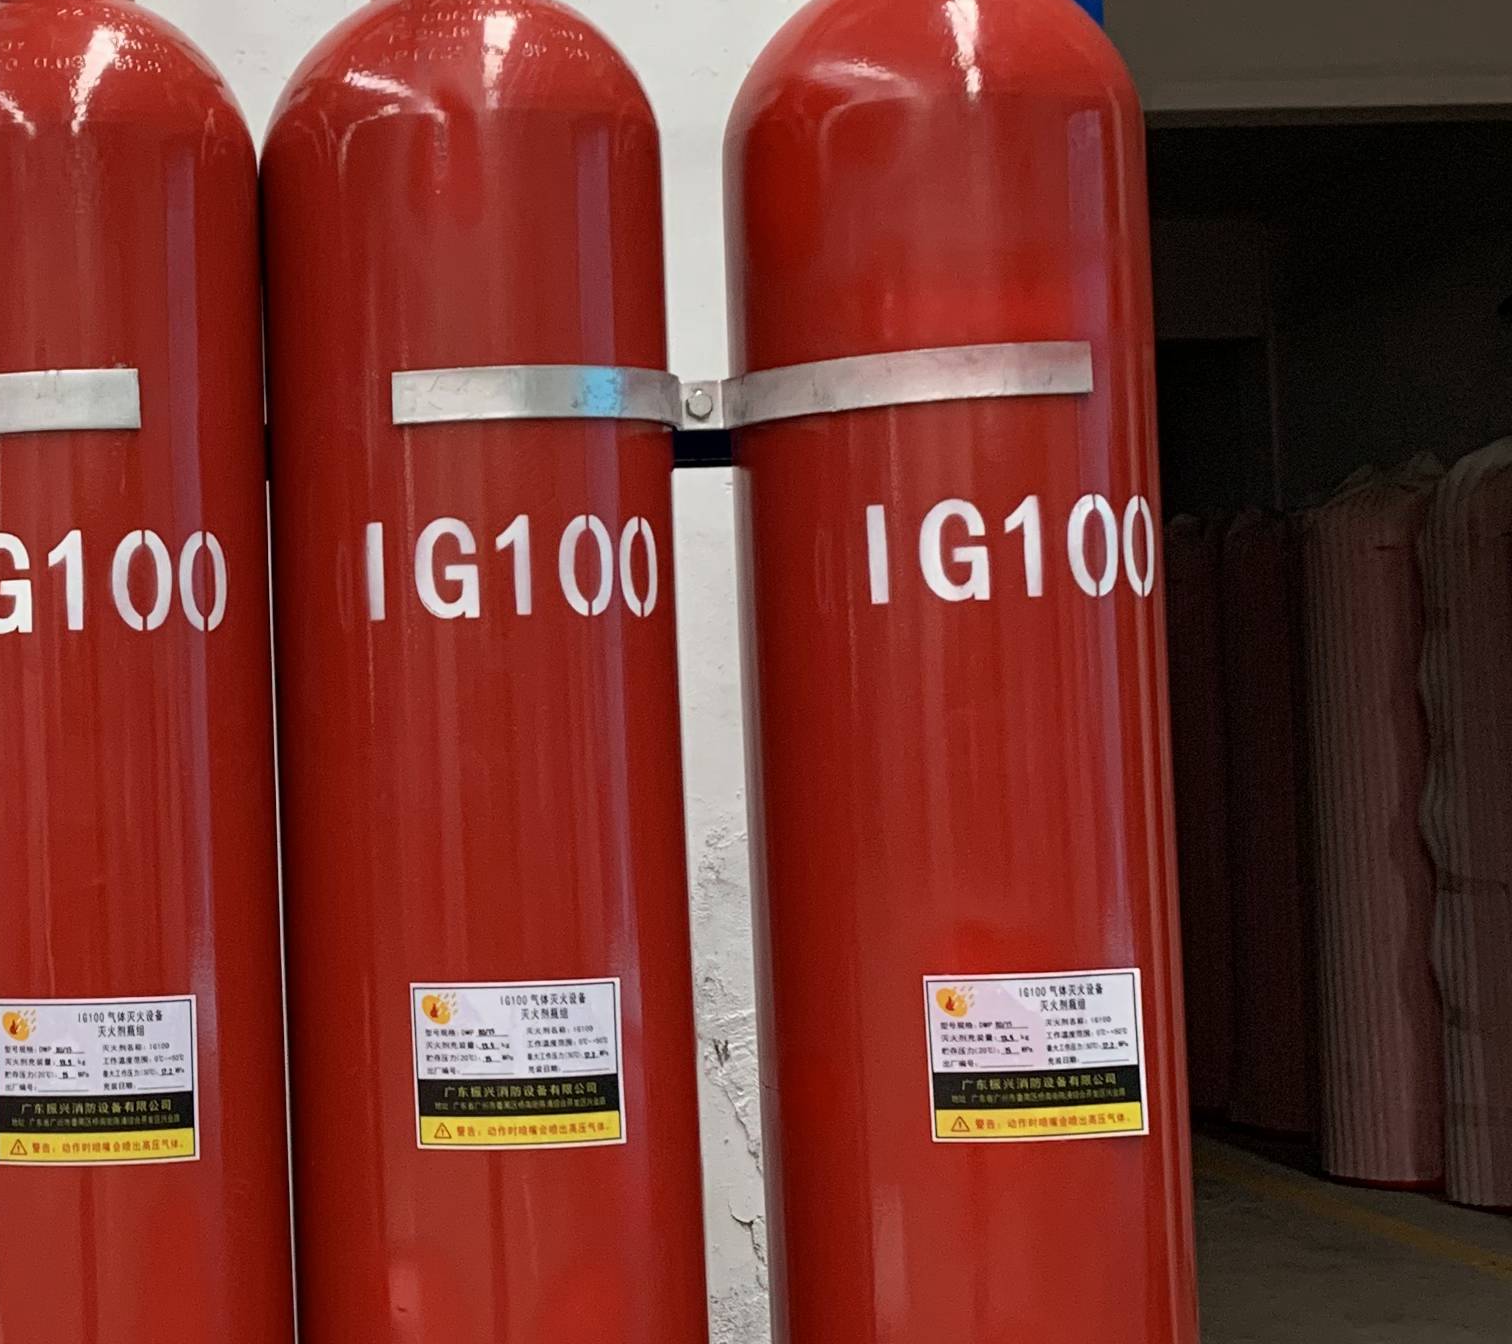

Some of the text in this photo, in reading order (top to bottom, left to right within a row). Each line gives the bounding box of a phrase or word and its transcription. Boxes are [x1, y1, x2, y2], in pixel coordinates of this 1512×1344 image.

[866, 493, 1154, 605] IG100
[365, 513, 659, 621] IG100
[1019, 984, 1103, 997] IG100 气体灭火设备
[500, 993, 586, 1006] IG100 气体灭火设备
[78, 1010, 163, 1023] IG100 气体灭火设备
